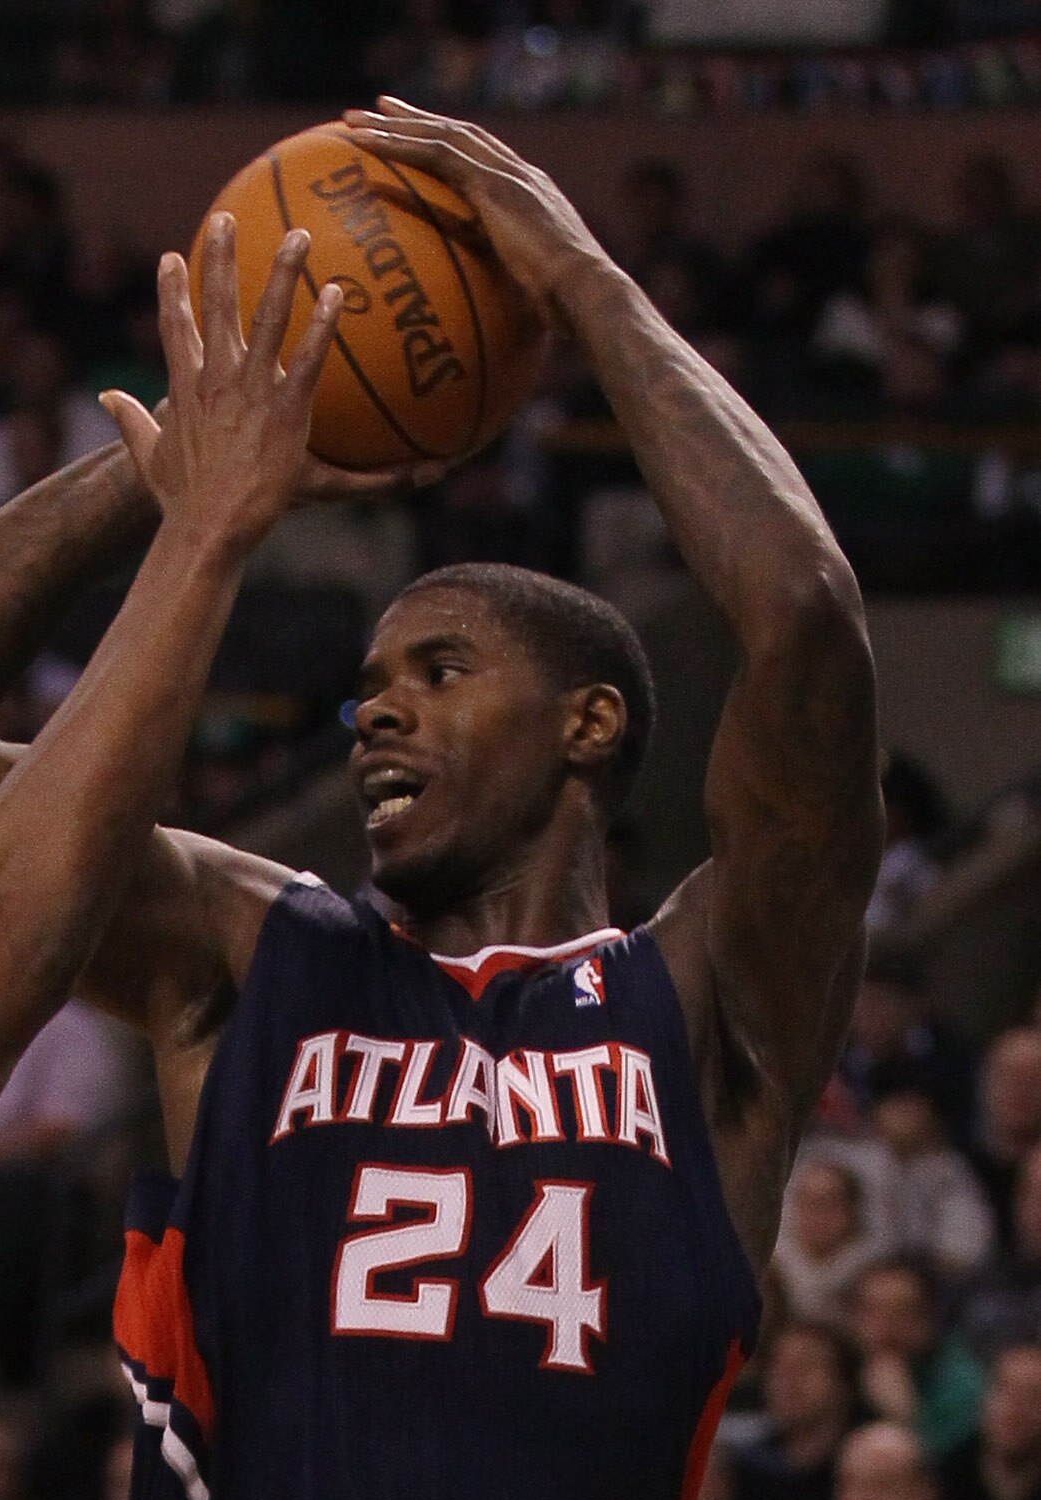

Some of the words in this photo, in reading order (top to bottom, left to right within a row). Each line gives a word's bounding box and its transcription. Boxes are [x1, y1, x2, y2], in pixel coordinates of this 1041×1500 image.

[311, 157, 466, 397] SPALDING
[269, 1029, 671, 1170] ATLANTA
[330, 1162, 608, 1375] 24
